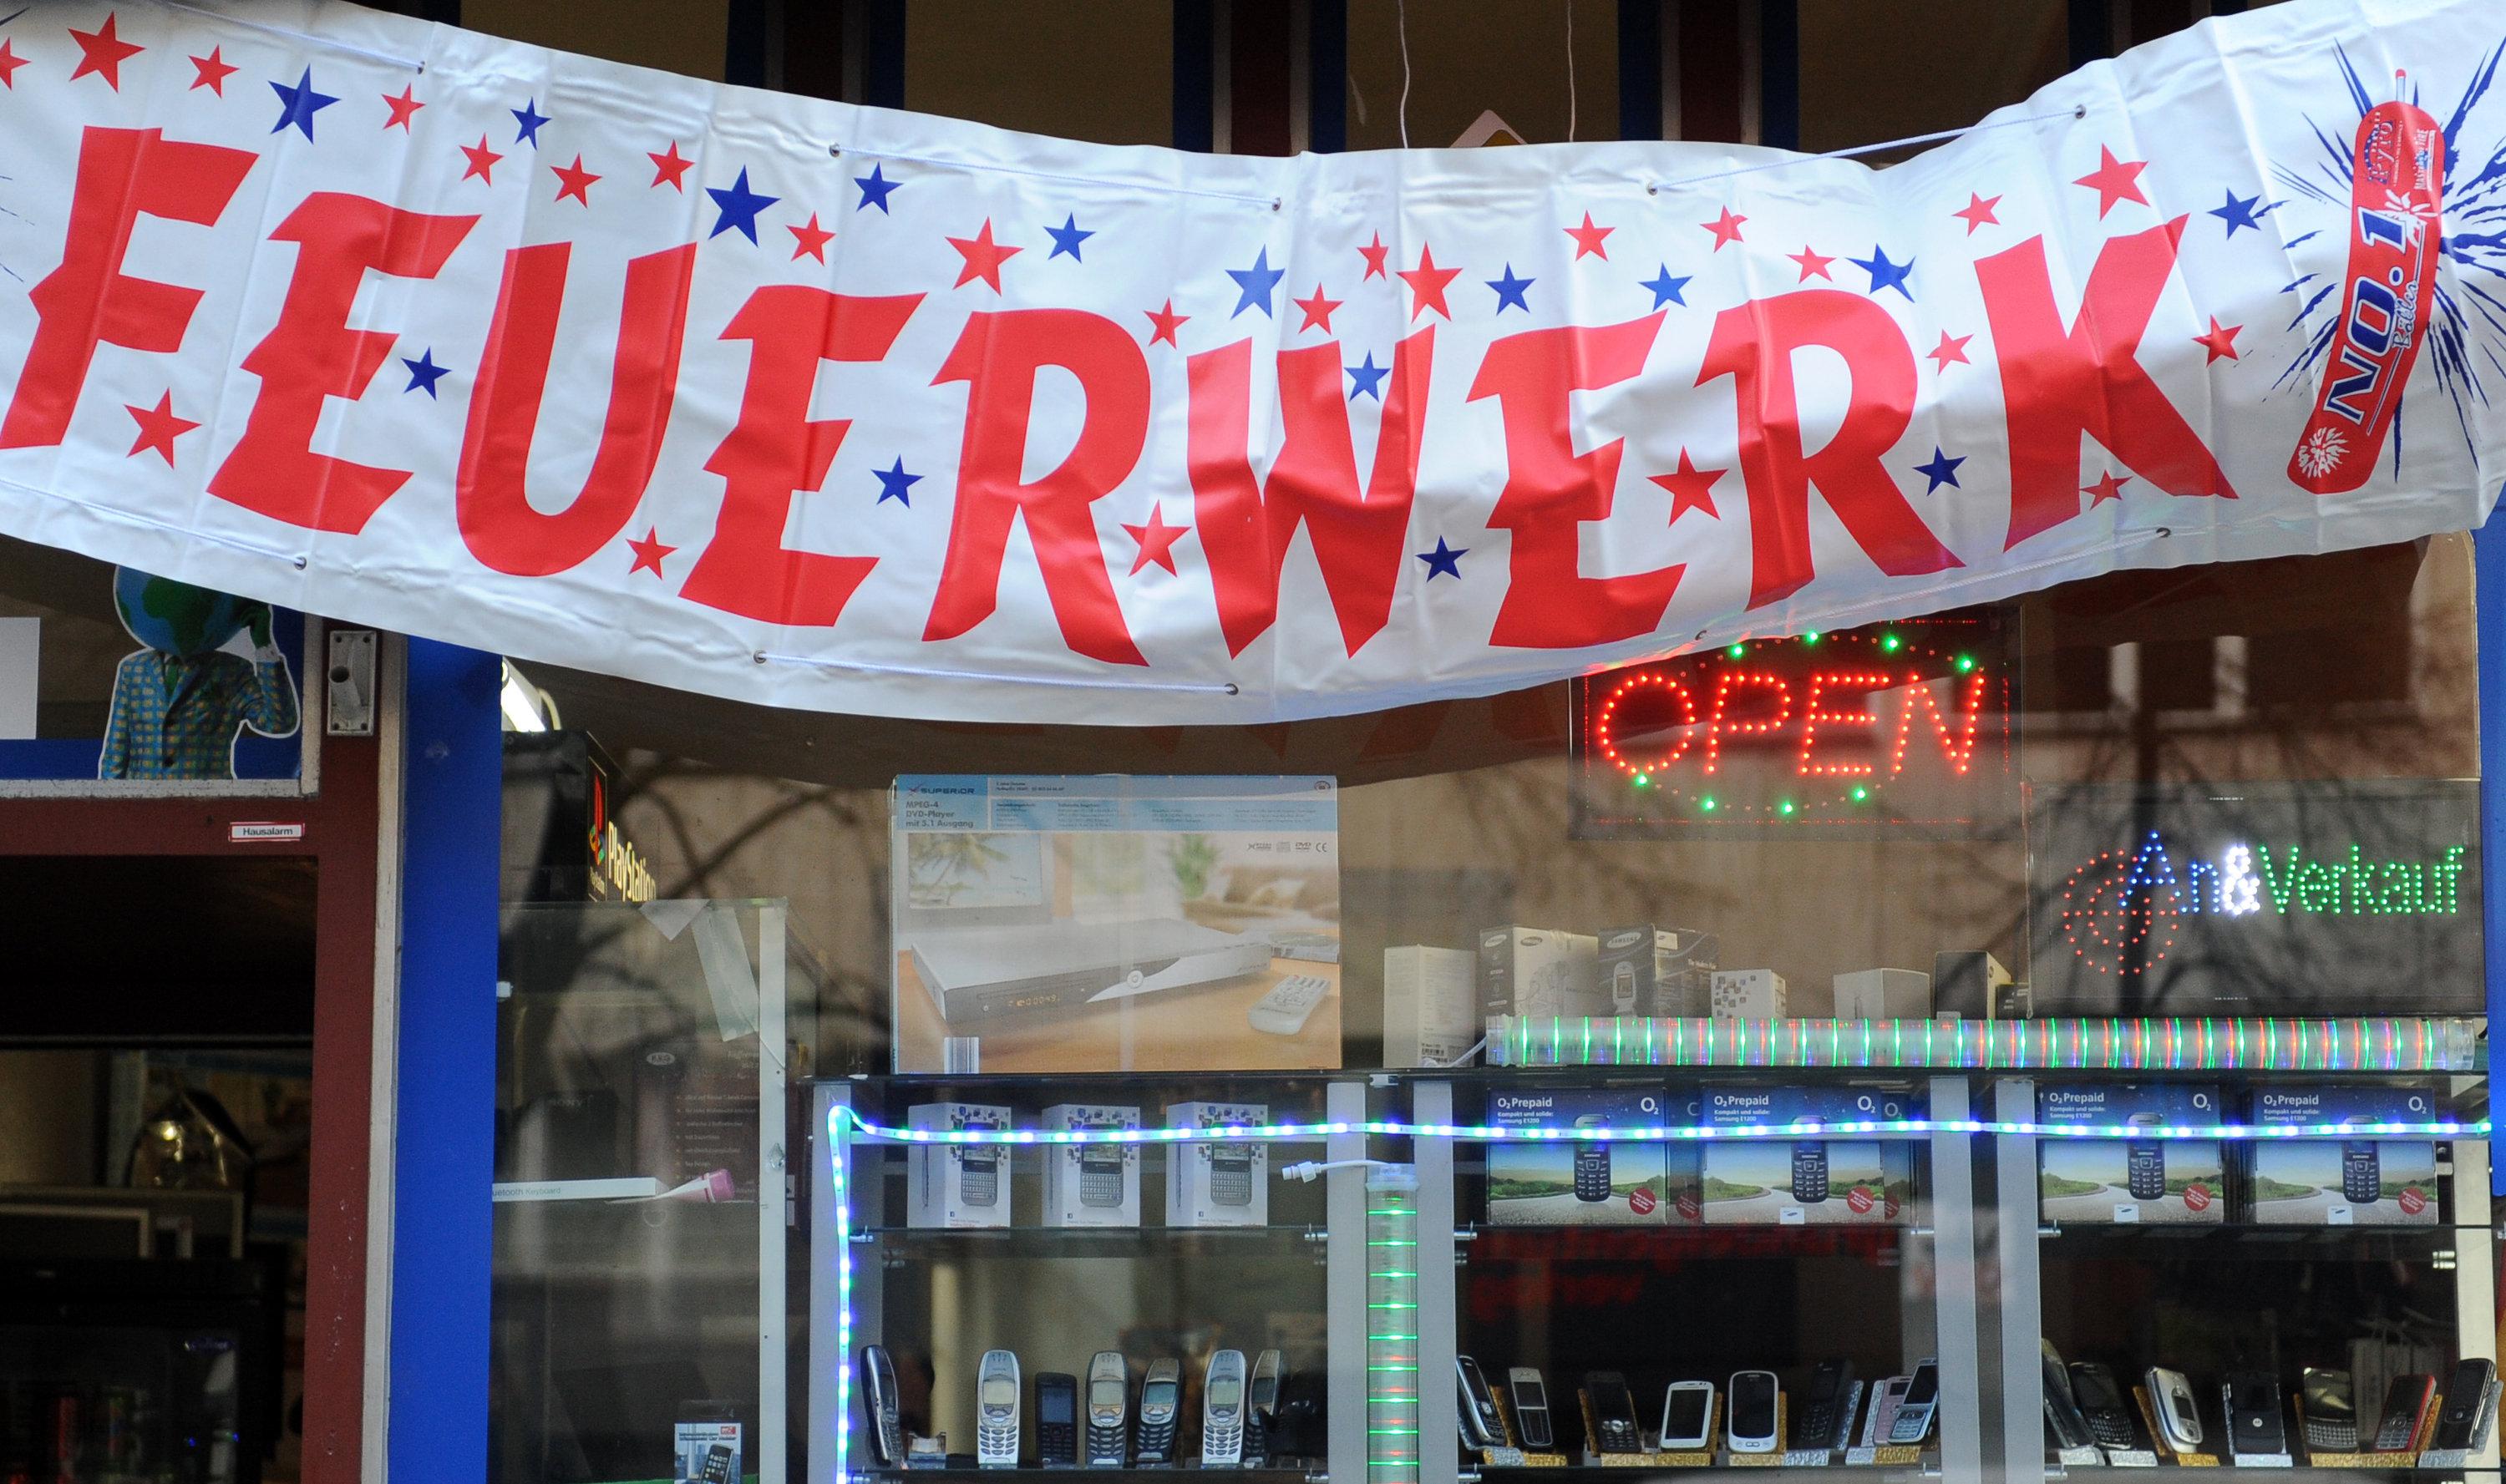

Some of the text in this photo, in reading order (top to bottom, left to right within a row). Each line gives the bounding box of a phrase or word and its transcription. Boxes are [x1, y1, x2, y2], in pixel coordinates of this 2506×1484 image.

[0, 126, 2233, 666] FEUERWERK
[1599, 672, 1986, 775] OPEN
[906, 810, 955, 818] DVD-Player
[937, 819, 974, 828] Ausgang
[242, 827, 293, 836] Hausalarm
[608, 820, 657, 902] PlayStation
[1512, 1097, 1552, 1109] Prepaid
[1728, 1095, 1769, 1107] Prepaid
[2063, 1092, 2104, 1104] Prepaid
[2278, 1094, 2319, 1107] Prepaid
